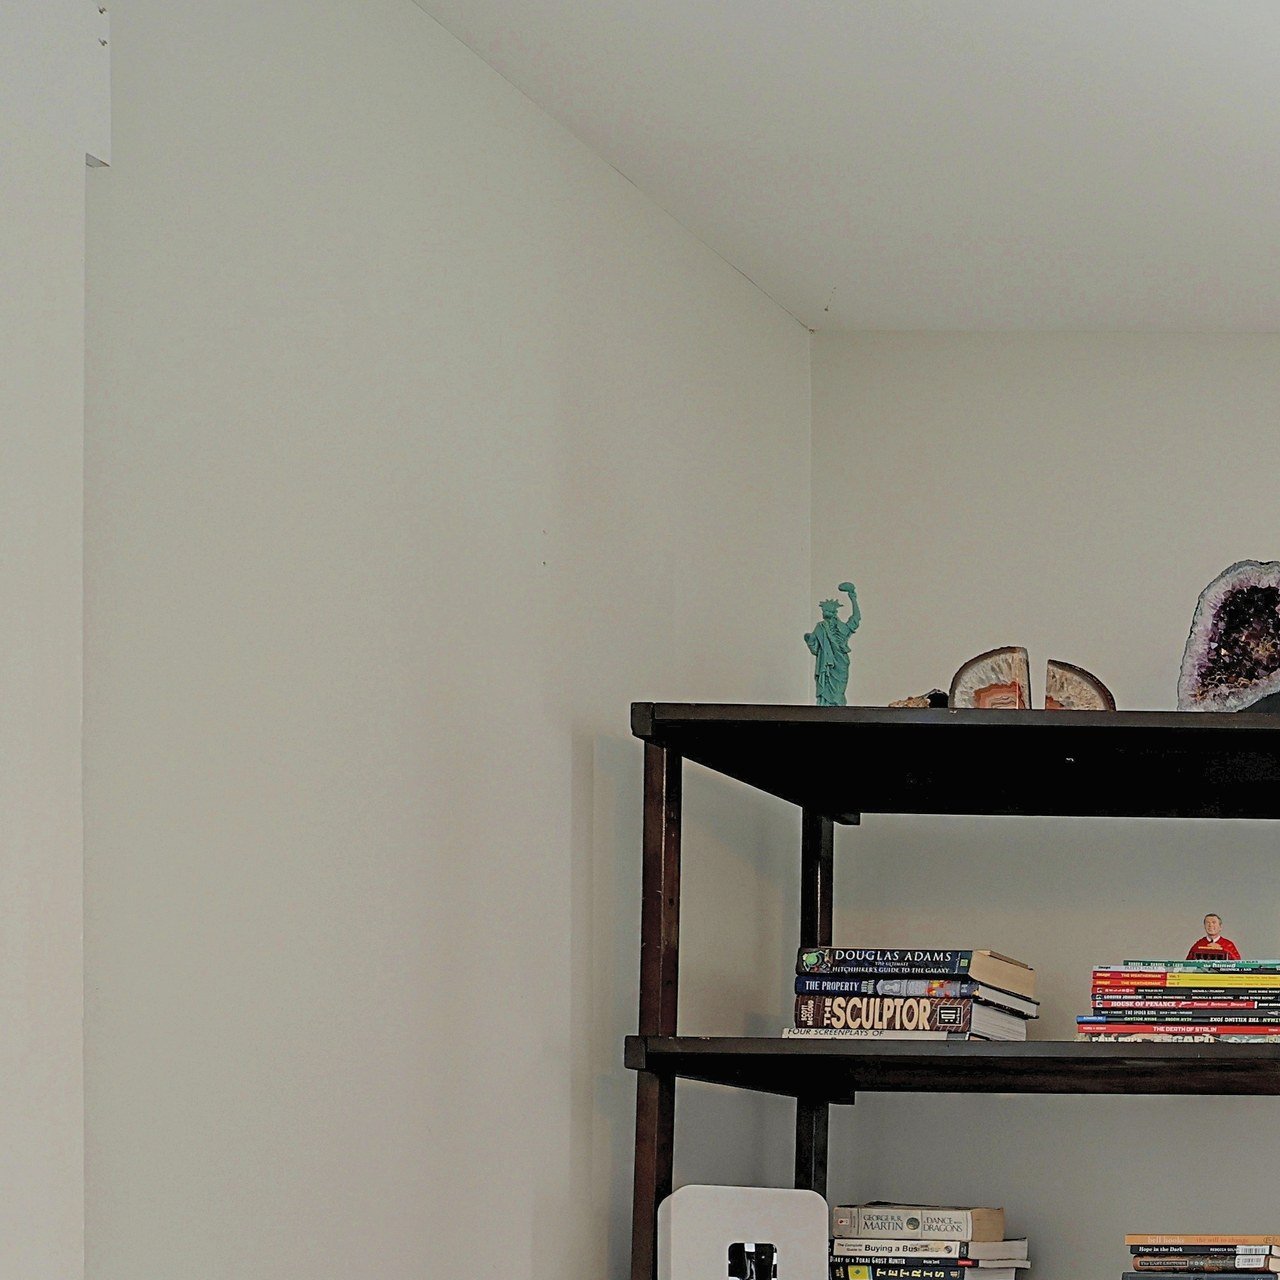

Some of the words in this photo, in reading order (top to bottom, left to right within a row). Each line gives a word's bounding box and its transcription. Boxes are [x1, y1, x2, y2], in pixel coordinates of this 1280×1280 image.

[835, 950, 899, 961] DOUGLAS
[905, 952, 952, 962] ADAMS
[832, 966, 878, 974] HITCHHIKER'S
[805, 980, 820, 991] THE
[821, 981, 860, 992] PROPERTY
[823, 997, 832, 1027] THE
[831, 997, 931, 1030] SCULPTOR
[788, 1028, 811, 1036] FOUR
[814, 1029, 869, 1037] SCREENPLAYS
[863, 1221, 904, 1231] MARTIN
[926, 1217, 953, 1225] DANCE
[923, 1224, 963, 1232] DRAGONS
[1147, 1235, 1161, 1243] bell
[1163, 1235, 1185, 1243] hooks
[864, 1244, 892, 1254] Buying
[876, 1268, 945, 1279] TETRIS
